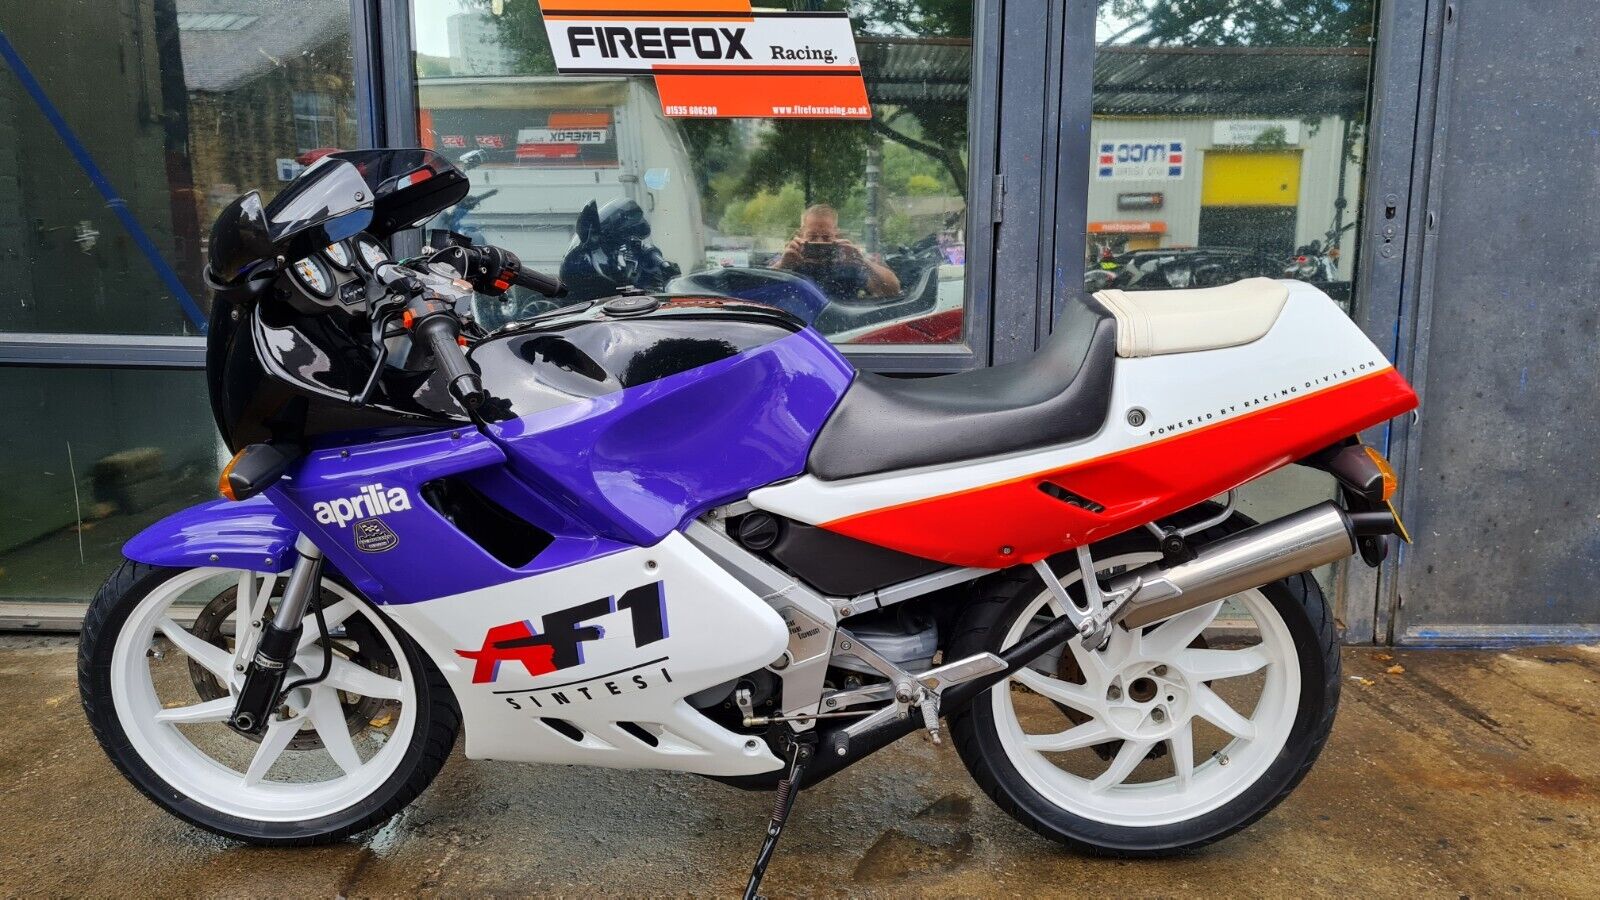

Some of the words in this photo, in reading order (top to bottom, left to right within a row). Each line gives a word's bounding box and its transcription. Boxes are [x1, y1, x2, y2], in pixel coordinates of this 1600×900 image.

[567, 26, 753, 60] FIREFOX
[769, 45, 838, 64] Racing.
[665, 105, 688, 115] 01535
[772, 104, 867, 116] www.firefoxracing.co.uk
[1149, 412, 1213, 437] POWERED
[1220, 405, 1236, 416] BY
[1244, 386, 1297, 408] RACING
[1305, 360, 1376, 388] DIVISION
[313, 482, 412, 528] aprilia
[453, 579, 670, 684] AF1
[506, 667, 673, 710] SINTESI
